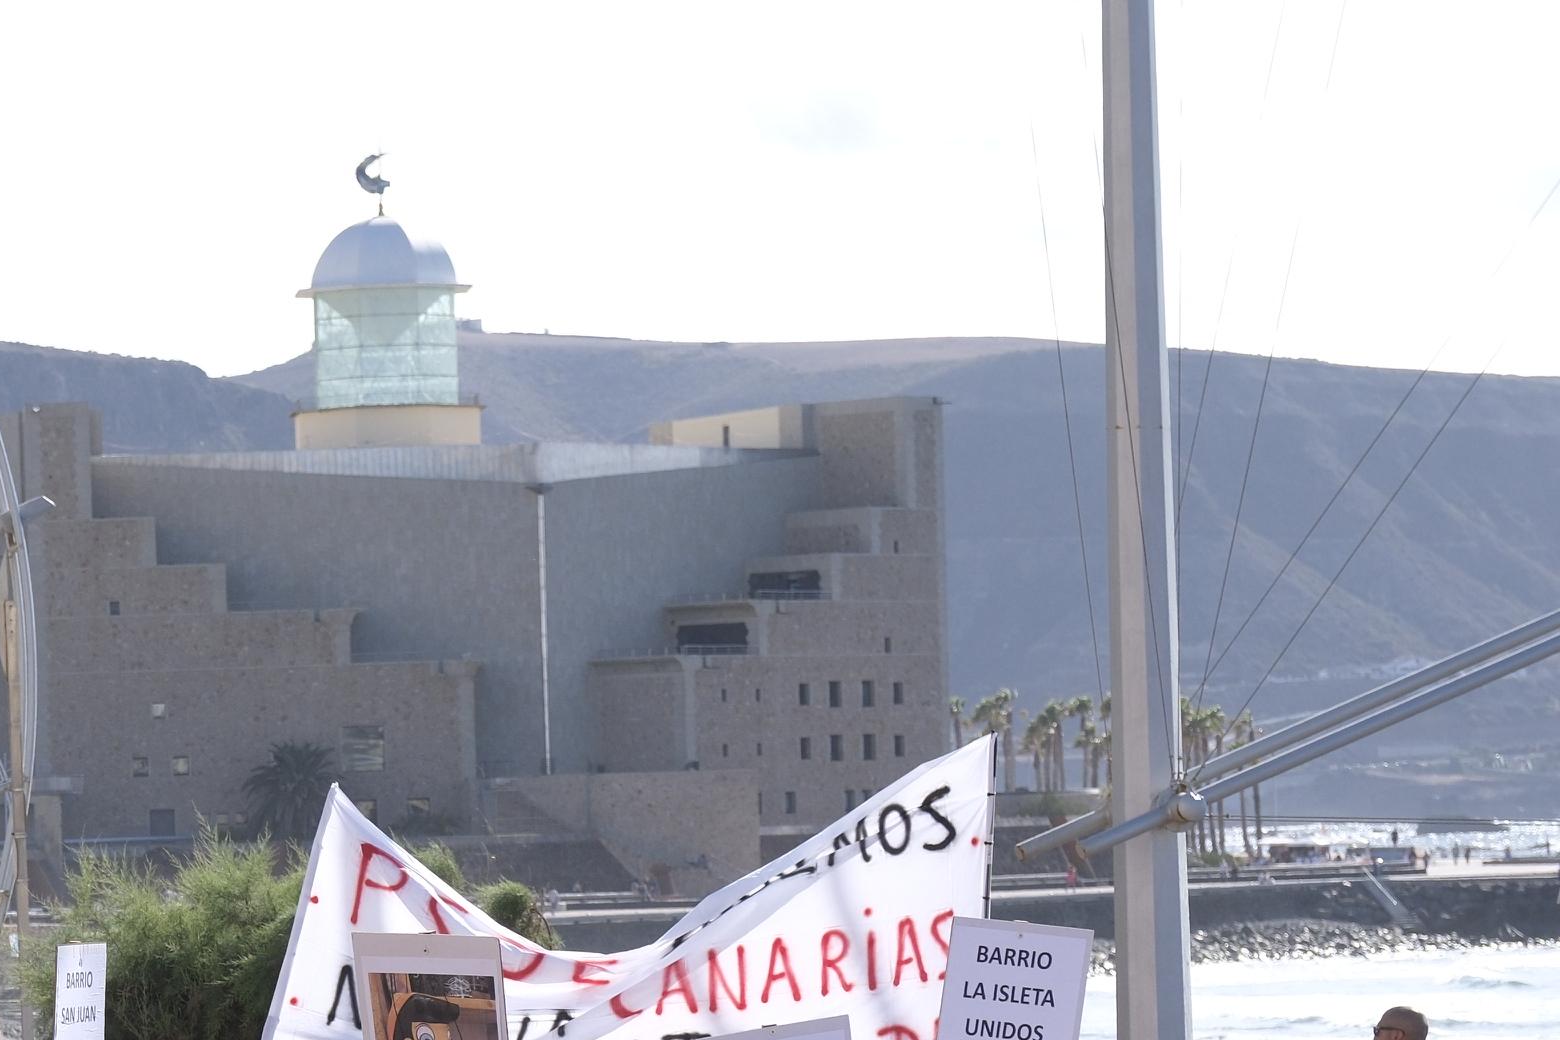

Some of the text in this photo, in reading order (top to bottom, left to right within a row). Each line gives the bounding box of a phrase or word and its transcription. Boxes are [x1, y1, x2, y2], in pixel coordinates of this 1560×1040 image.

[976, 945, 1052, 970] BARRIO
[66, 971, 93, 989] BARRIO
[962, 981, 1055, 1007] LA ISLETA
[61, 1005, 96, 1024] SAN JUAN
